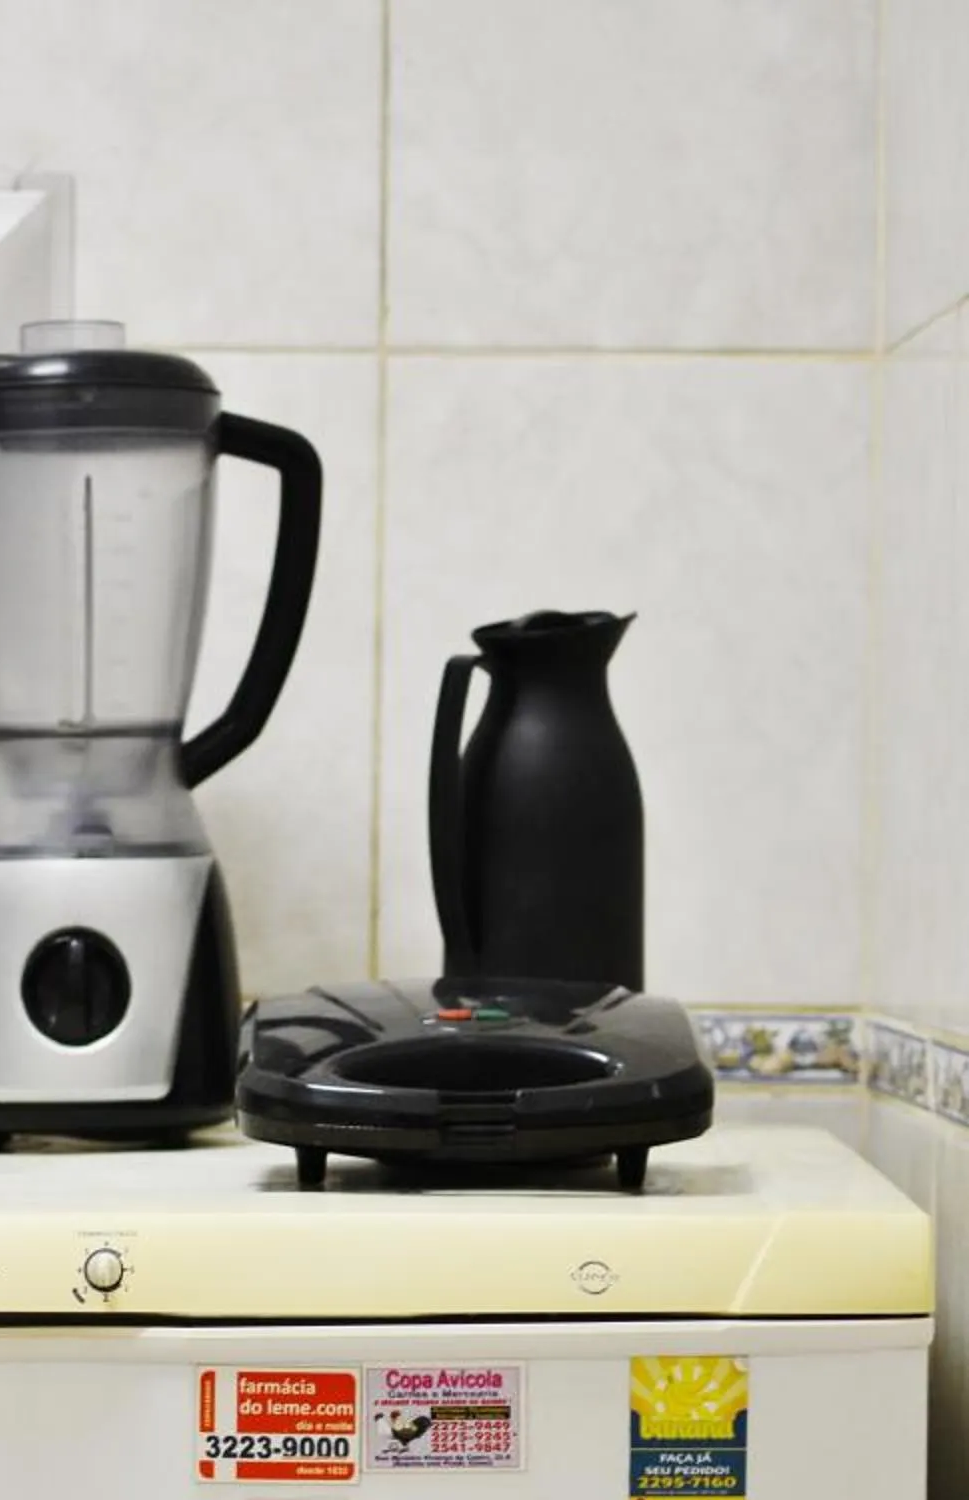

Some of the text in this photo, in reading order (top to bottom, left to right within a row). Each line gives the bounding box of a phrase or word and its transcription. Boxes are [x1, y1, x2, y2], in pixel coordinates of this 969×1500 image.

[239, 1377, 317, 1395] farmácia
[386, 1369, 432, 1391] Copa
[239, 1399, 354, 1416] do leme.com
[205, 1435, 350, 1459] 3223-9000
[659, 1450, 712, 1465] FAÇA JÁ
[643, 1465, 671, 1475] SEU
[637, 1475, 738, 1489] 2295-7160
